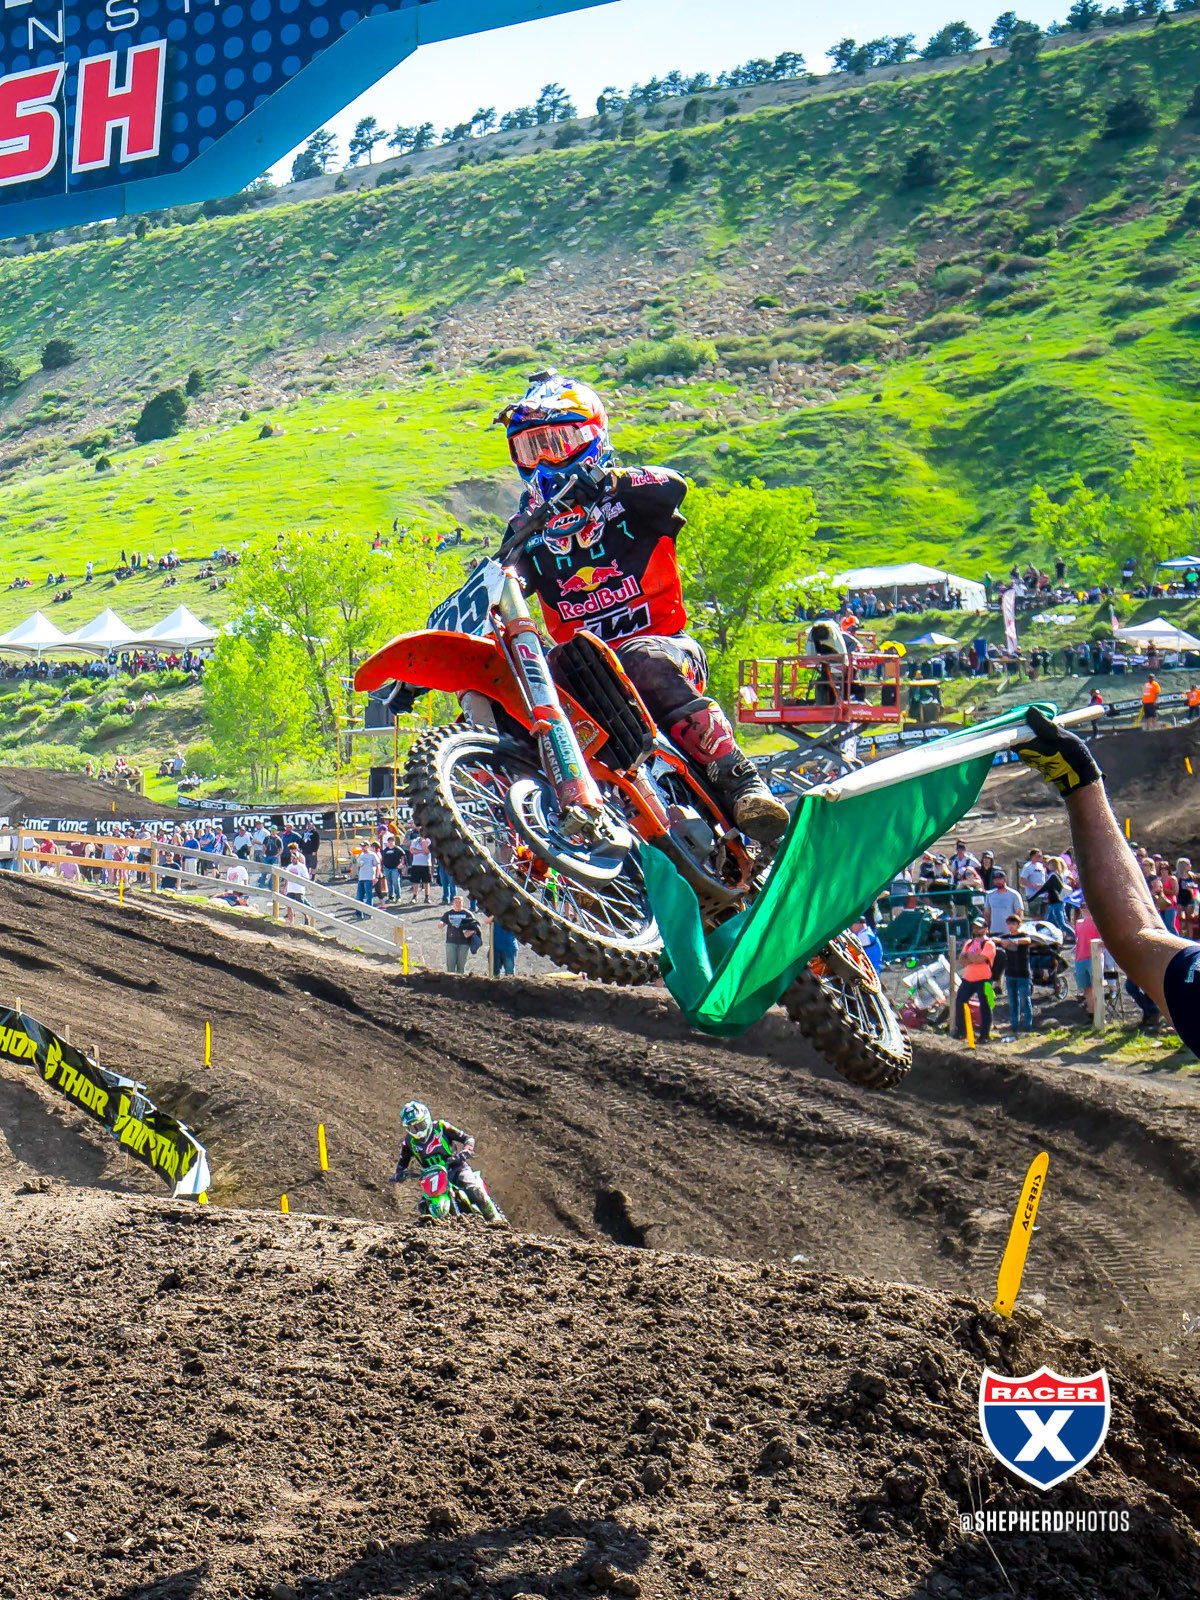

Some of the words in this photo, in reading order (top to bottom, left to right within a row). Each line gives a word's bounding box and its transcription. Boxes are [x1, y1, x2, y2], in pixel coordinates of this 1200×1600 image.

[553, 513, 581, 529] KTM
[558, 592, 601, 620] Red
[596, 575, 641, 610] Bull
[574, 602, 651, 642] KTM
[1113, 699, 1143, 711] GEIC
[553, 722, 577, 765] MOTOREX
[57, 820, 88, 832] KMC
[233, 815, 272, 828] KMC
[283, 812, 324, 826] KMC
[335, 810, 378, 826] KMC
[390, 807, 414, 820] KM
[58, 1059, 110, 1118] THOR
[429, 1174, 440, 1193] 1
[1021, 1174, 1042, 1232] ACERBIS
